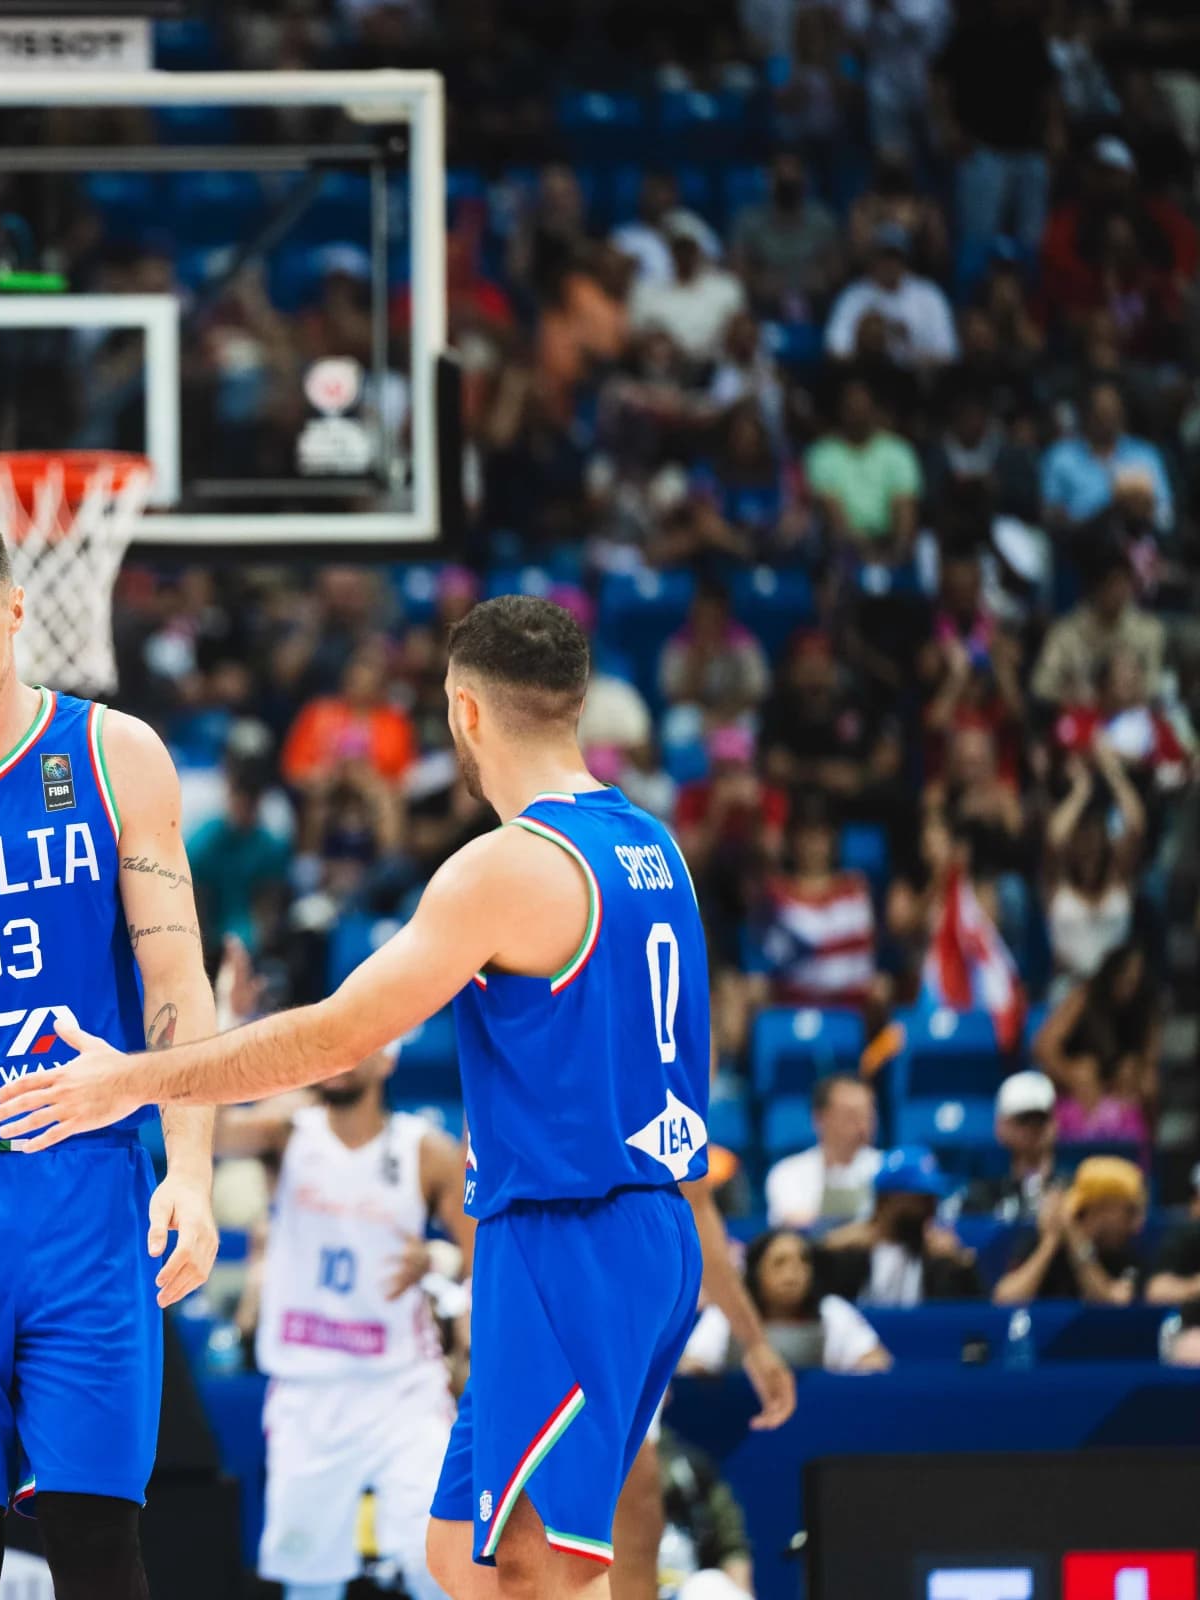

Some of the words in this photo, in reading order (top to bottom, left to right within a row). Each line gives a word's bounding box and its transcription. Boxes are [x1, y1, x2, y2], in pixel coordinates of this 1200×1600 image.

[48, 785, 70, 797] FIBA
[122, 856, 159, 873] Talent
[615, 844, 673, 890] SPISSU
[646, 923, 680, 1063] 0
[319, 1246, 357, 1294] 10
